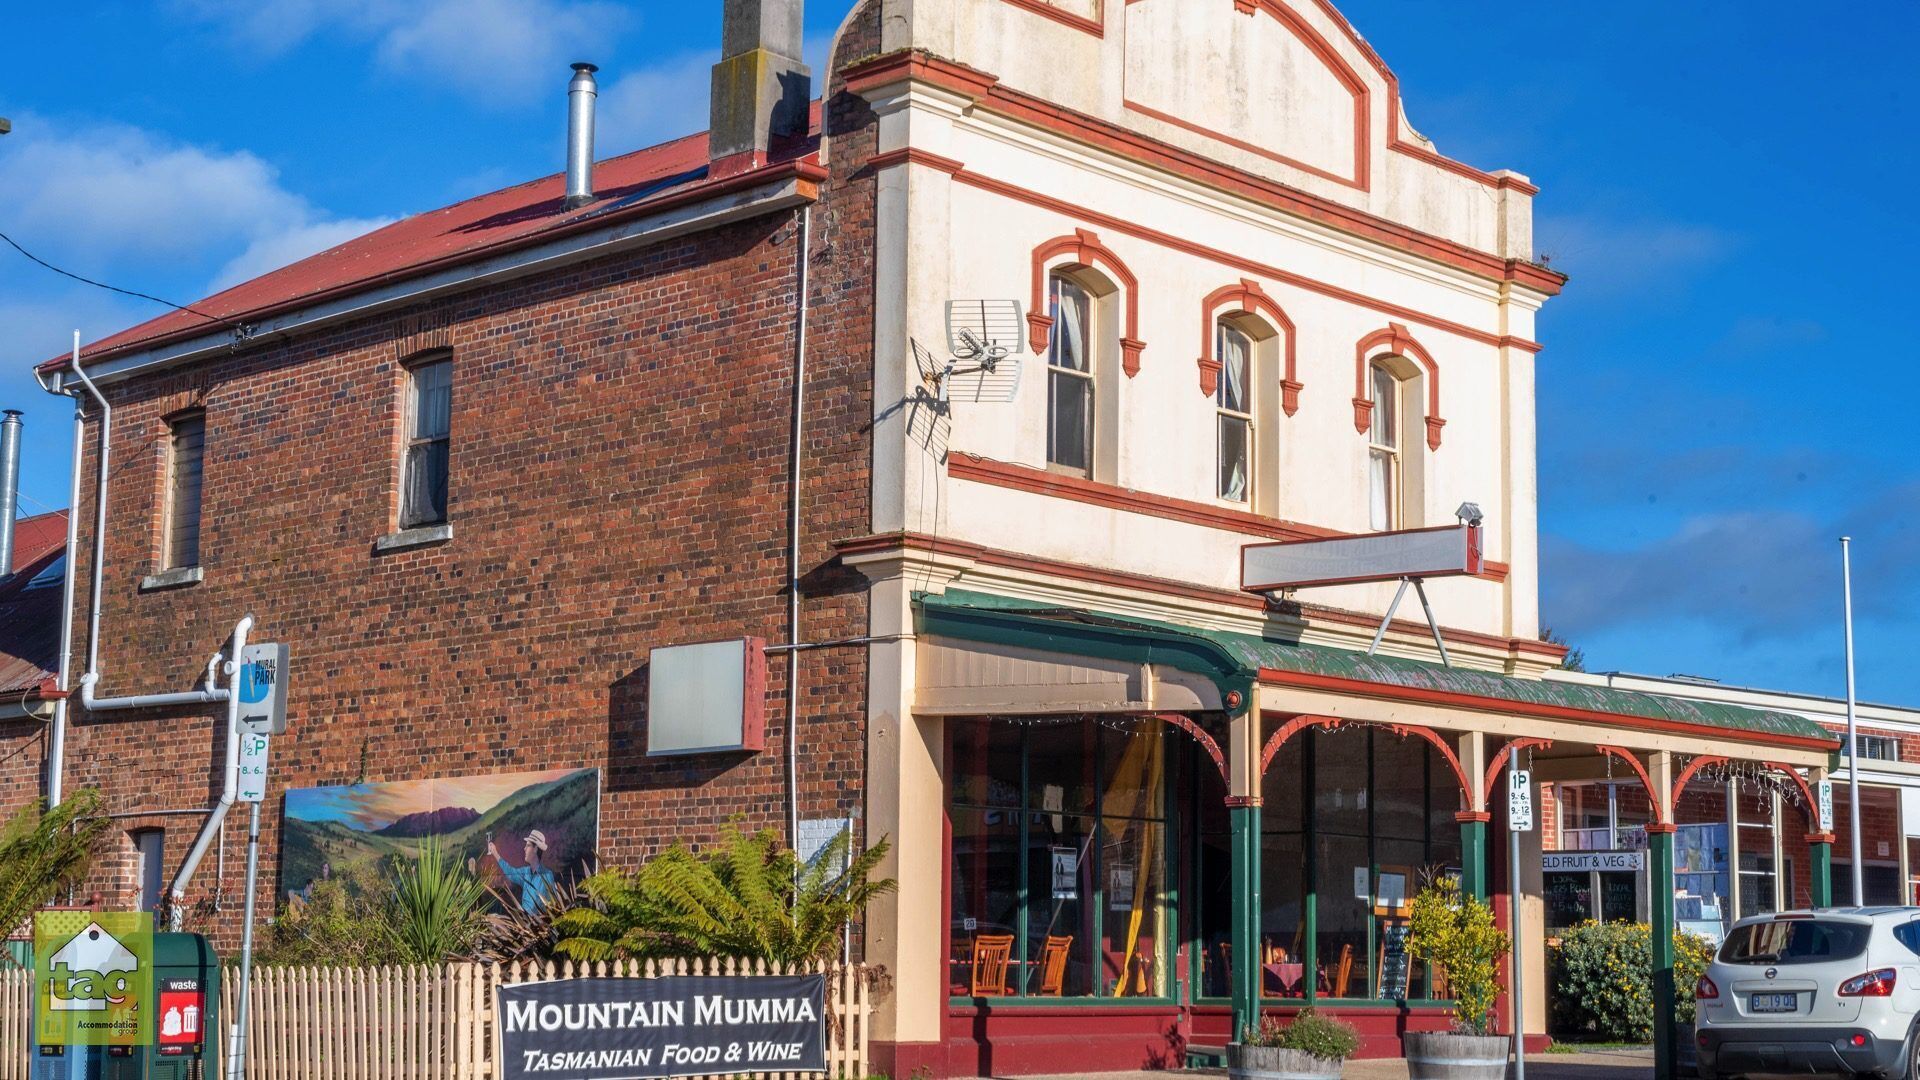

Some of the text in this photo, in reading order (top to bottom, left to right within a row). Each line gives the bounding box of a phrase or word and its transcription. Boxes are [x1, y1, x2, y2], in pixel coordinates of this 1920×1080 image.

[255, 659, 275, 670] MURAL
[254, 669, 275, 685] PARK
[1512, 774, 1527, 789] 1P
[1821, 785, 1831, 796] 1P
[1562, 856, 1587, 868] FRUIT
[1592, 855, 1600, 867] &
[1603, 855, 1625, 867] VEG
[170, 979, 198, 990] waste
[505, 994, 818, 1033] MOUNTAIN MUMMA
[522, 1040, 803, 1073] TASMANIAN FOOD & WINE
